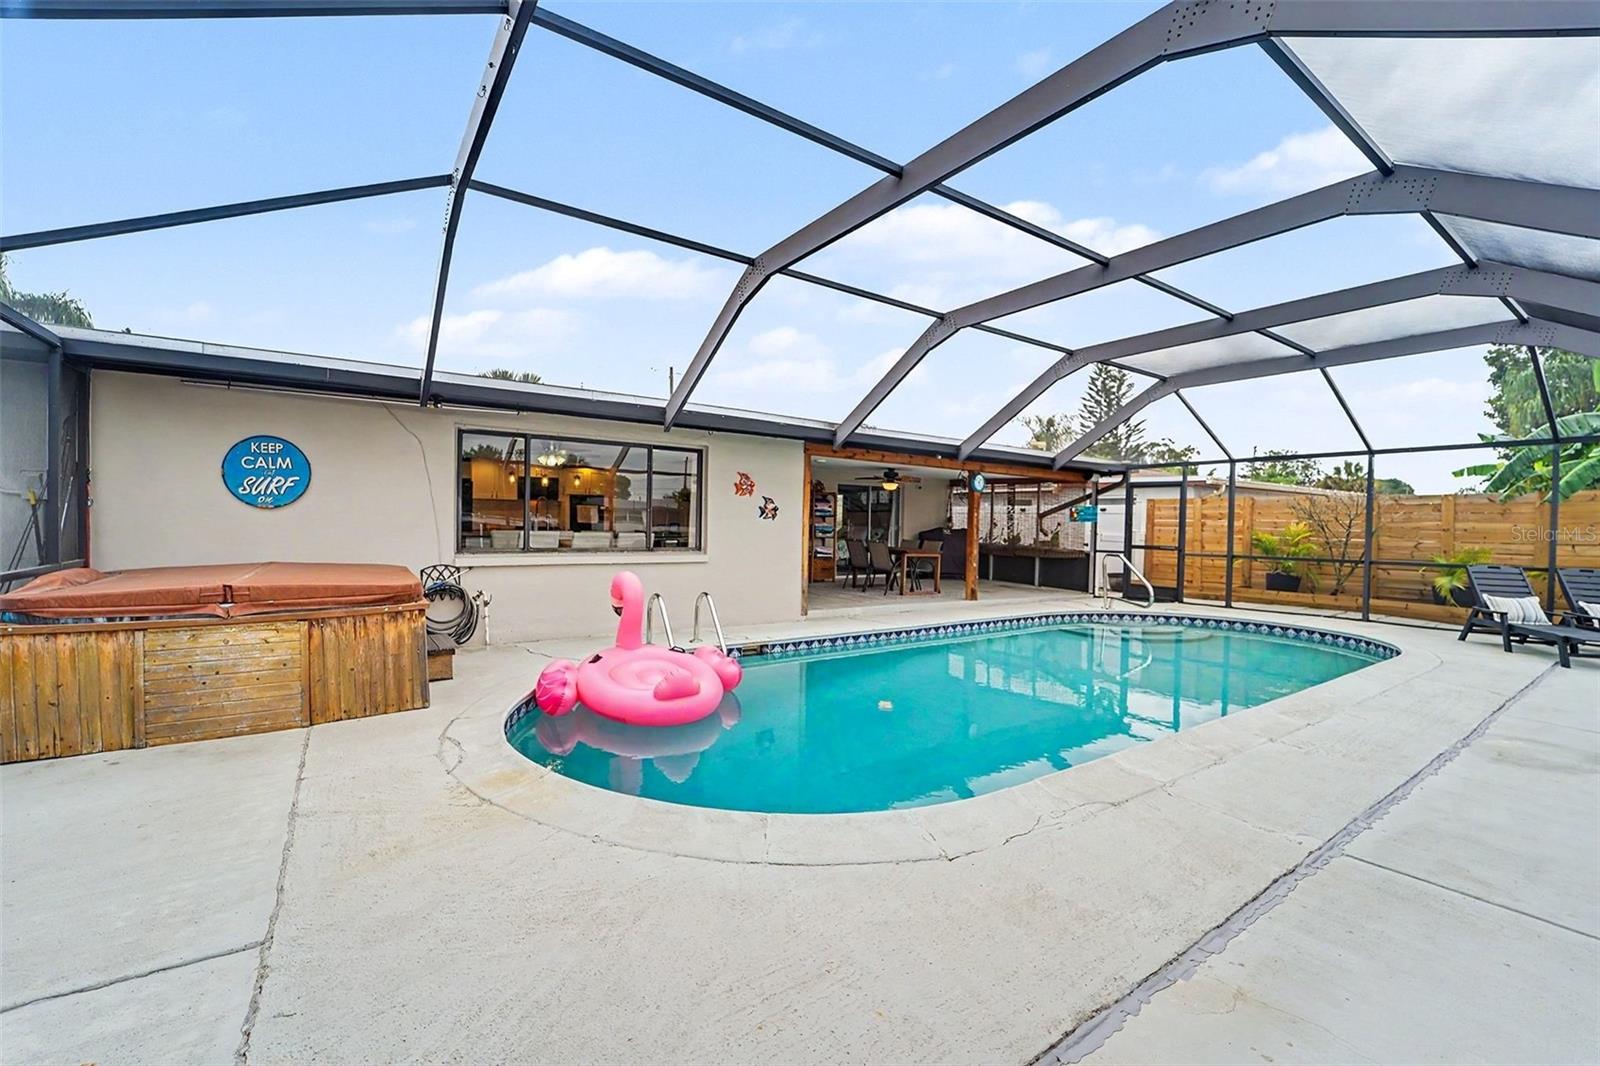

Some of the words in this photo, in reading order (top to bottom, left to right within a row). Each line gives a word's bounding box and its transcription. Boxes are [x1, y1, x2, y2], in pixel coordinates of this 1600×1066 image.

[250, 441, 284, 454] KEEP
[241, 456, 293, 470] CALM
[239, 475, 300, 495] SURF
